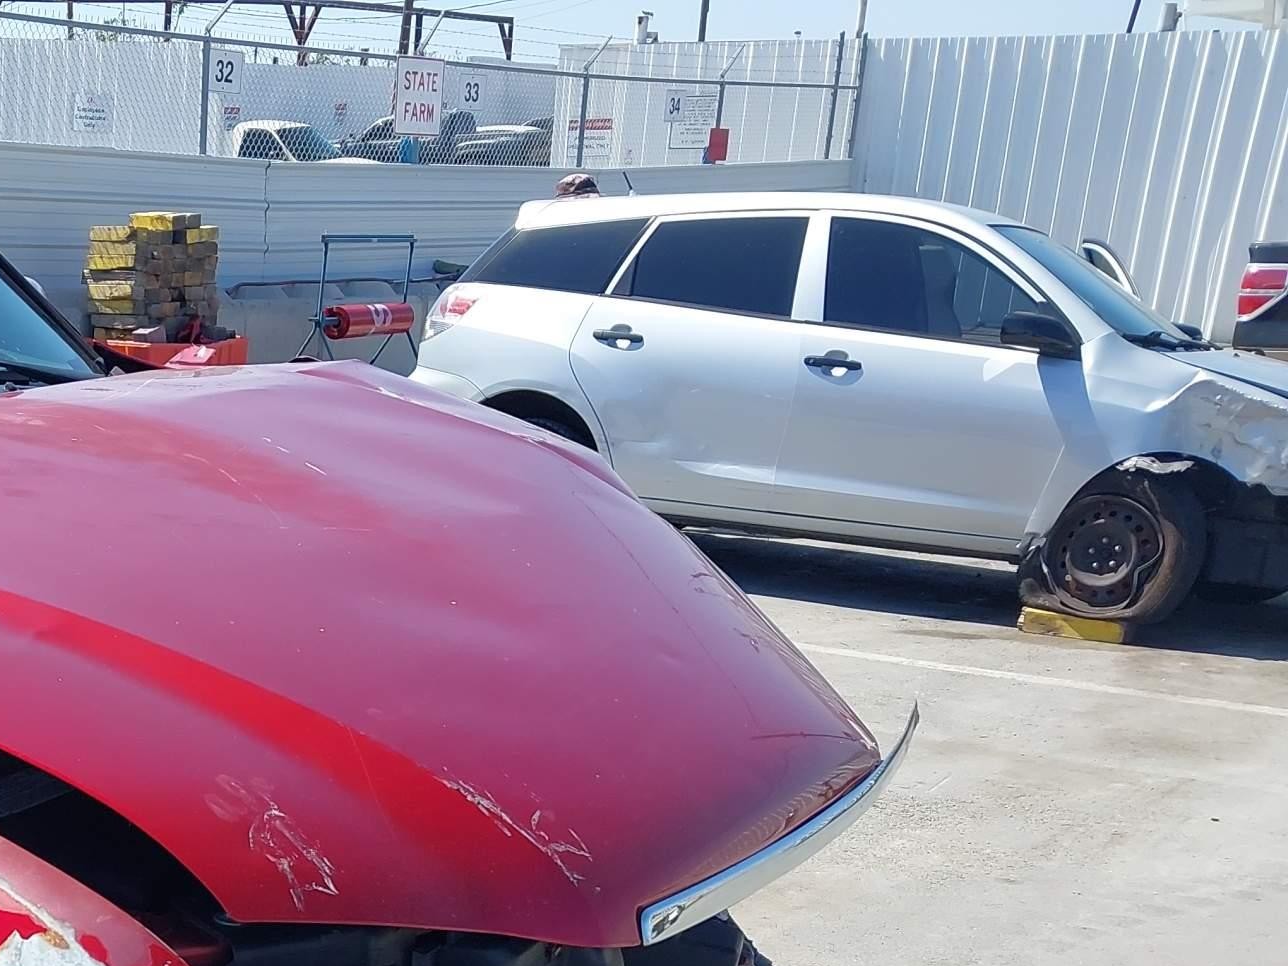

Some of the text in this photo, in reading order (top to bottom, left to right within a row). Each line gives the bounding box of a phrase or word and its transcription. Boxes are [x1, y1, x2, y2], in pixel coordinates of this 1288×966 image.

[215, 59, 234, 83] 32
[403, 70, 438, 92] STATE
[464, 81, 479, 103] 33
[403, 101, 434, 123] FARM
[669, 97, 681, 115] 34
